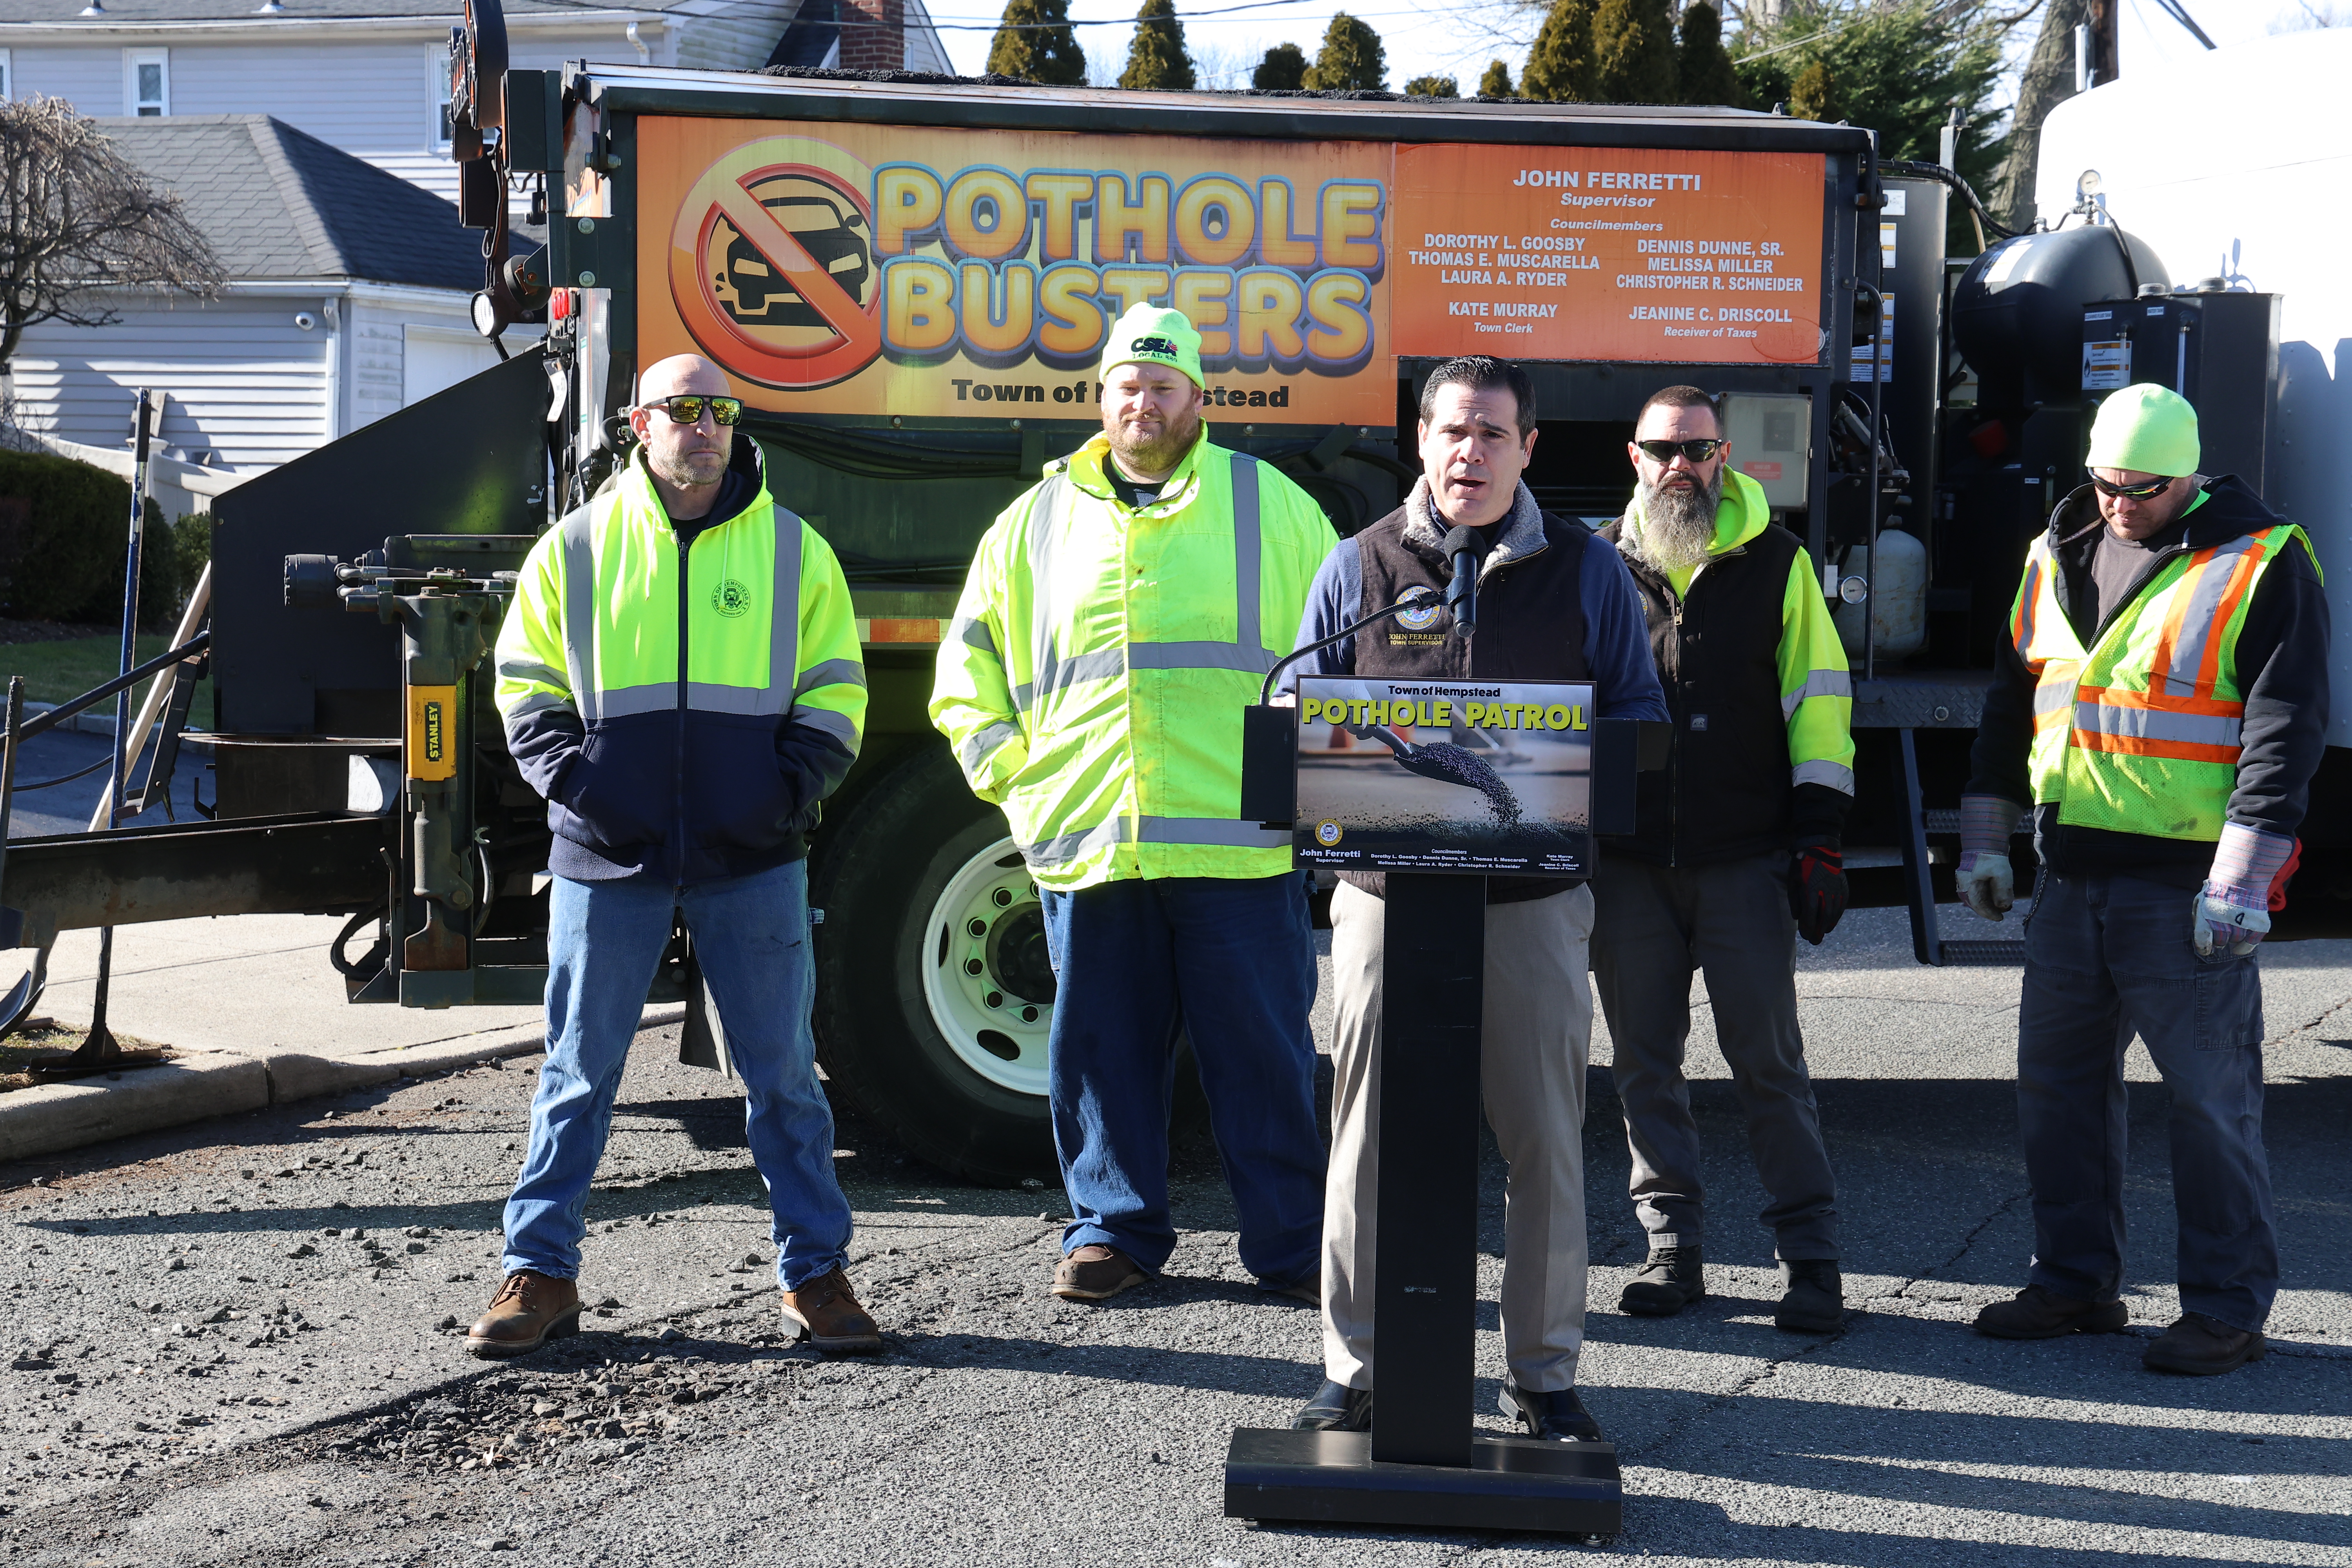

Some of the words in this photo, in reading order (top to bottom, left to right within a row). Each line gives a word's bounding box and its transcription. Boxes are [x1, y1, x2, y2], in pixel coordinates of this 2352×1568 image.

[1513, 169, 1579, 188] JOHN
[1587, 171, 1701, 191] FERRETTI
[1560, 192, 1657, 209] Supervisor
[871, 160, 1385, 271] POTHOLE
[1550, 218, 1663, 231] Councilmembers
[1425, 233, 1499, 249] DOROTHY
[1503, 236, 1517, 250] L.
[1521, 236, 1586, 251] GOOSBY
[1637, 239, 1695, 254] DENNIS
[1699, 240, 1756, 258] DUNNE,
[1760, 241, 1785, 256] SR.
[1408, 250, 1474, 266] THOMAS
[1479, 252, 1493, 267] E.
[1497, 253, 1601, 270] MUSCARELLA
[1648, 257, 1714, 272] MELISSA
[1718, 258, 1773, 273] MILLER
[1441, 269, 1493, 285] LAURA
[1496, 271, 1512, 285] A.
[1516, 271, 1567, 287] RYDER
[1616, 274, 1709, 290] CHRISTOPHER
[1712, 276, 1725, 290] R.
[1728, 276, 1804, 292] SCHNEIDER
[881, 255, 1374, 370] BUSTERS
[1449, 301, 1489, 316] KATE
[1494, 303, 1559, 318] MURRAY
[1628, 306, 1695, 321] JEANINE
[1699, 307, 1715, 321] C.
[1718, 307, 1793, 323] DRISCOLL
[1474, 322, 1503, 332] Town
[1504, 322, 1534, 333] Clerk
[1664, 326, 1711, 337] Receiver
[1712, 327, 1725, 337] of
[1726, 327, 1758, 338] Taxes
[1131, 338, 1177, 356] CSEA
[952, 379, 1044, 403] Town
[1053, 381, 1087, 403] of
[1388, 685, 1419, 695] Town
[1421, 686, 1433, 695] of
[1435, 686, 1500, 699] Hempstead
[1303, 698, 1451, 727] POTHOLE
[1466, 702, 1588, 731] PATROL
[428, 705, 439, 758] STANLEY
[1325, 849, 1361, 858] Ferretti
